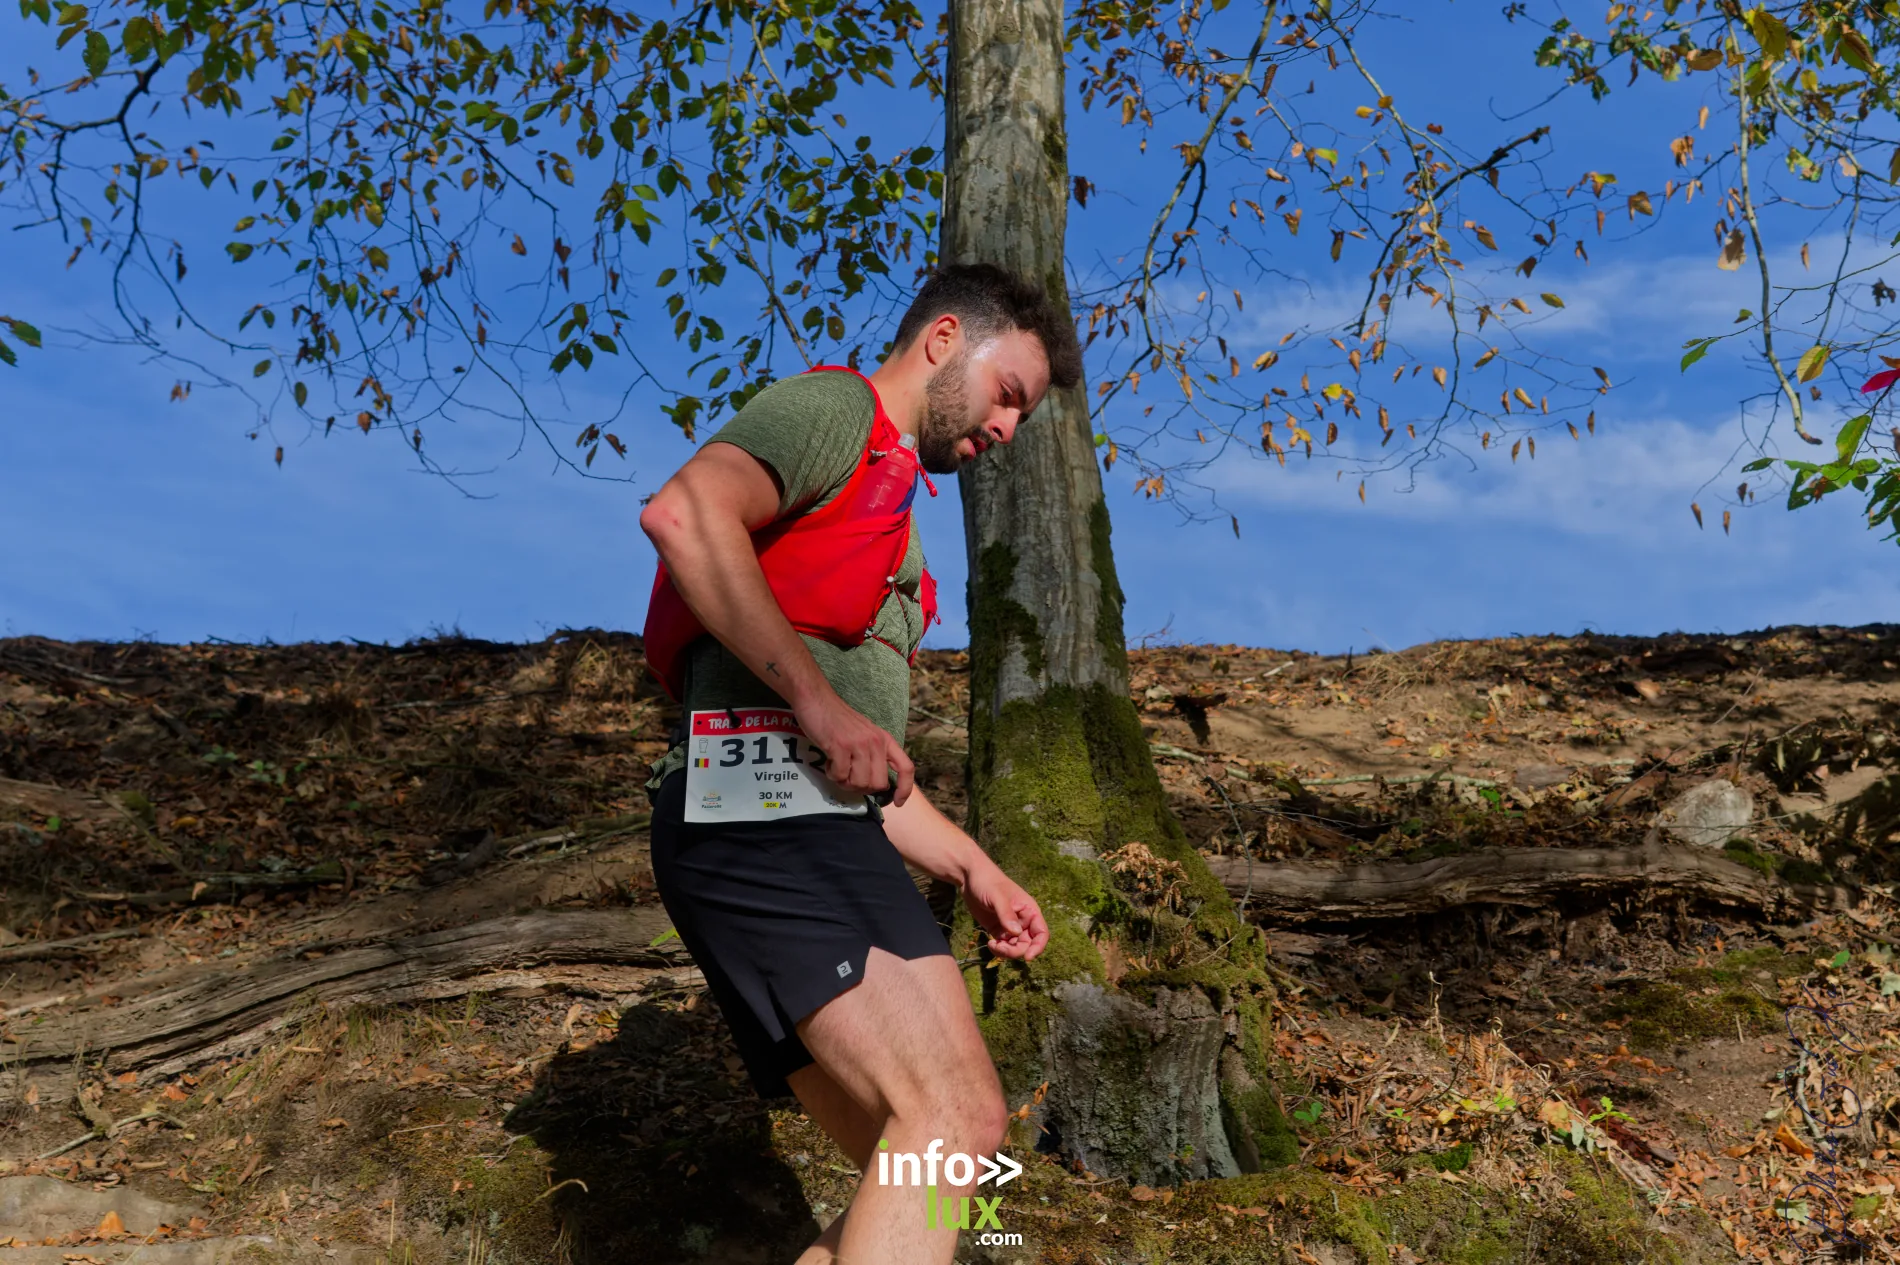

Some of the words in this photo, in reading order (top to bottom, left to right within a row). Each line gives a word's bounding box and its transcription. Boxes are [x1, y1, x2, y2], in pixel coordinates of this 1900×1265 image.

[708, 717, 742, 729] TRA
[745, 716, 761, 728] DE
[763, 715, 779, 726] LA
[754, 770, 799, 783] Virgile
[758, 791, 773, 800] 30
[776, 791, 793, 800] KM
